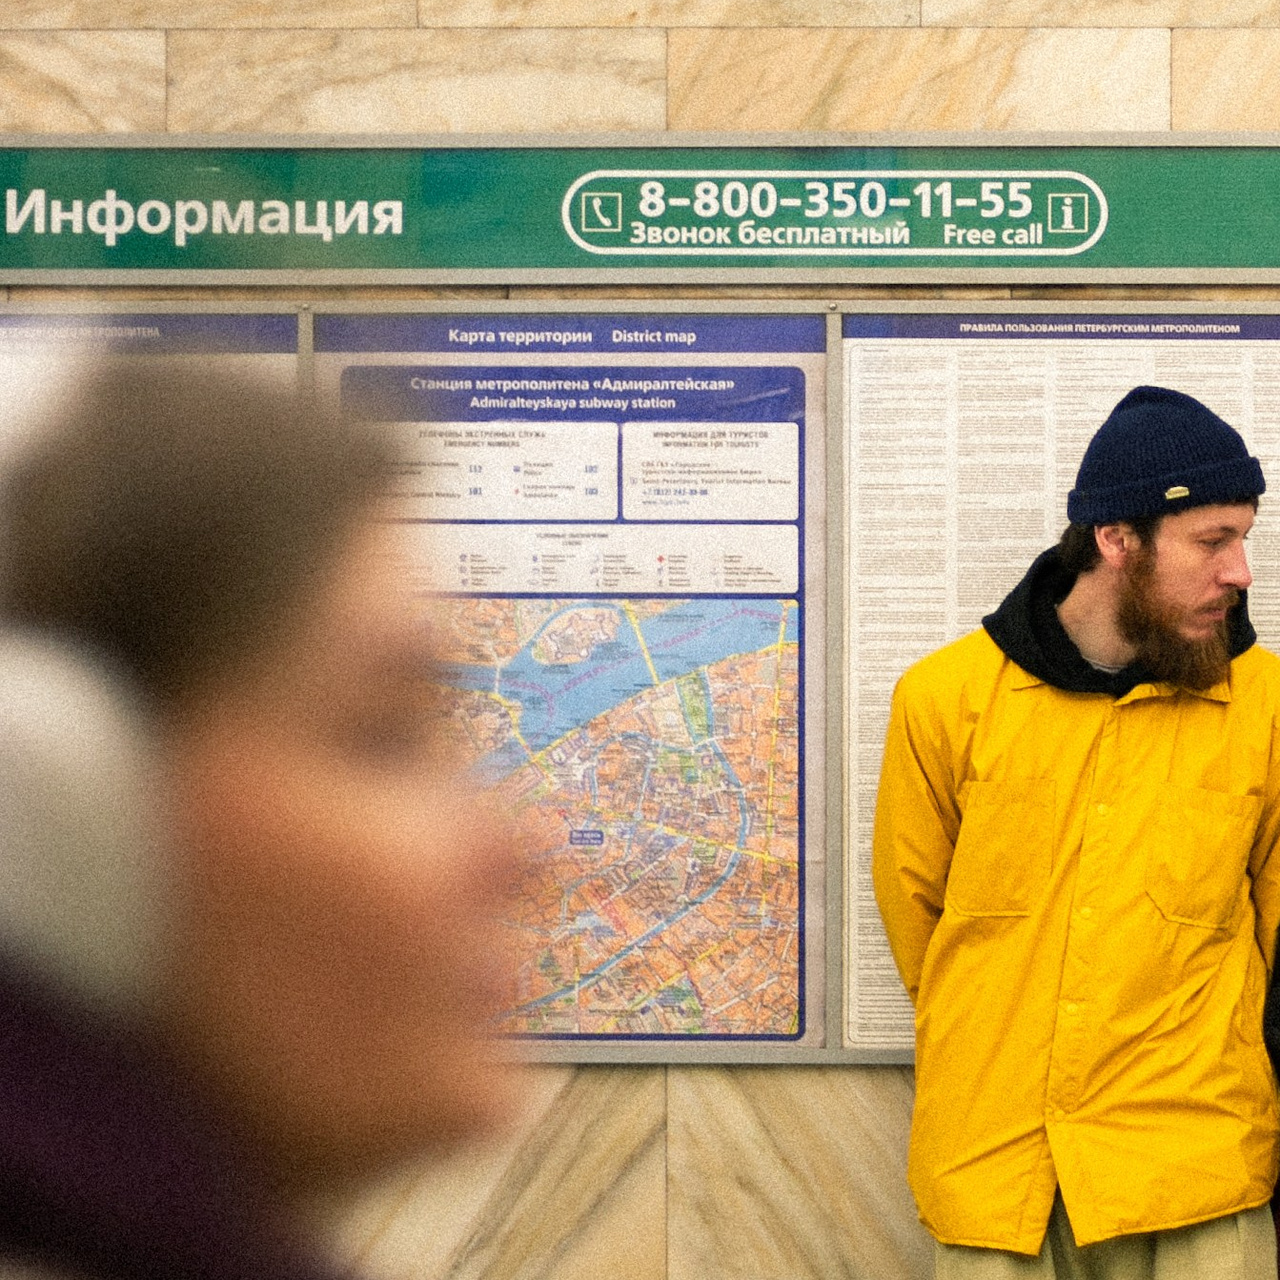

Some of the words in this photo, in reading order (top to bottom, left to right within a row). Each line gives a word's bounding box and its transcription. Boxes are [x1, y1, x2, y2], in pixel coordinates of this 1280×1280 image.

[637, 180, 1033, 219] 8-800-350-11-55
[5, 188, 404, 247] Информация
[629, 222, 732, 246] Звонок
[738, 220, 911, 246] бесплатный
[943, 222, 997, 246] Free
[1001, 222, 1044, 246] call
[448, 329, 496, 345] Карта
[498, 331, 593, 345] территории
[611, 328, 662, 343] District
[665, 331, 697, 345] map
[959, 323, 1004, 333] ПРАВИЛА
[1004, 323, 1074, 333] ПОЛЬЗОВАНИЯ
[1074, 323, 1150, 334] ПЕТЕРБУРГСКИМ
[1150, 324, 1241, 334] МЕТРОПОЛИТЕНОМ
[410, 377, 473, 393] Станция
[475, 379, 590, 393] метрополитена
[592, 377, 736, 393] «Адмиралтейская»
[469, 396, 577, 411] Admiralteyskaya
[579, 396, 629, 411] subway
[631, 396, 677, 409] station
